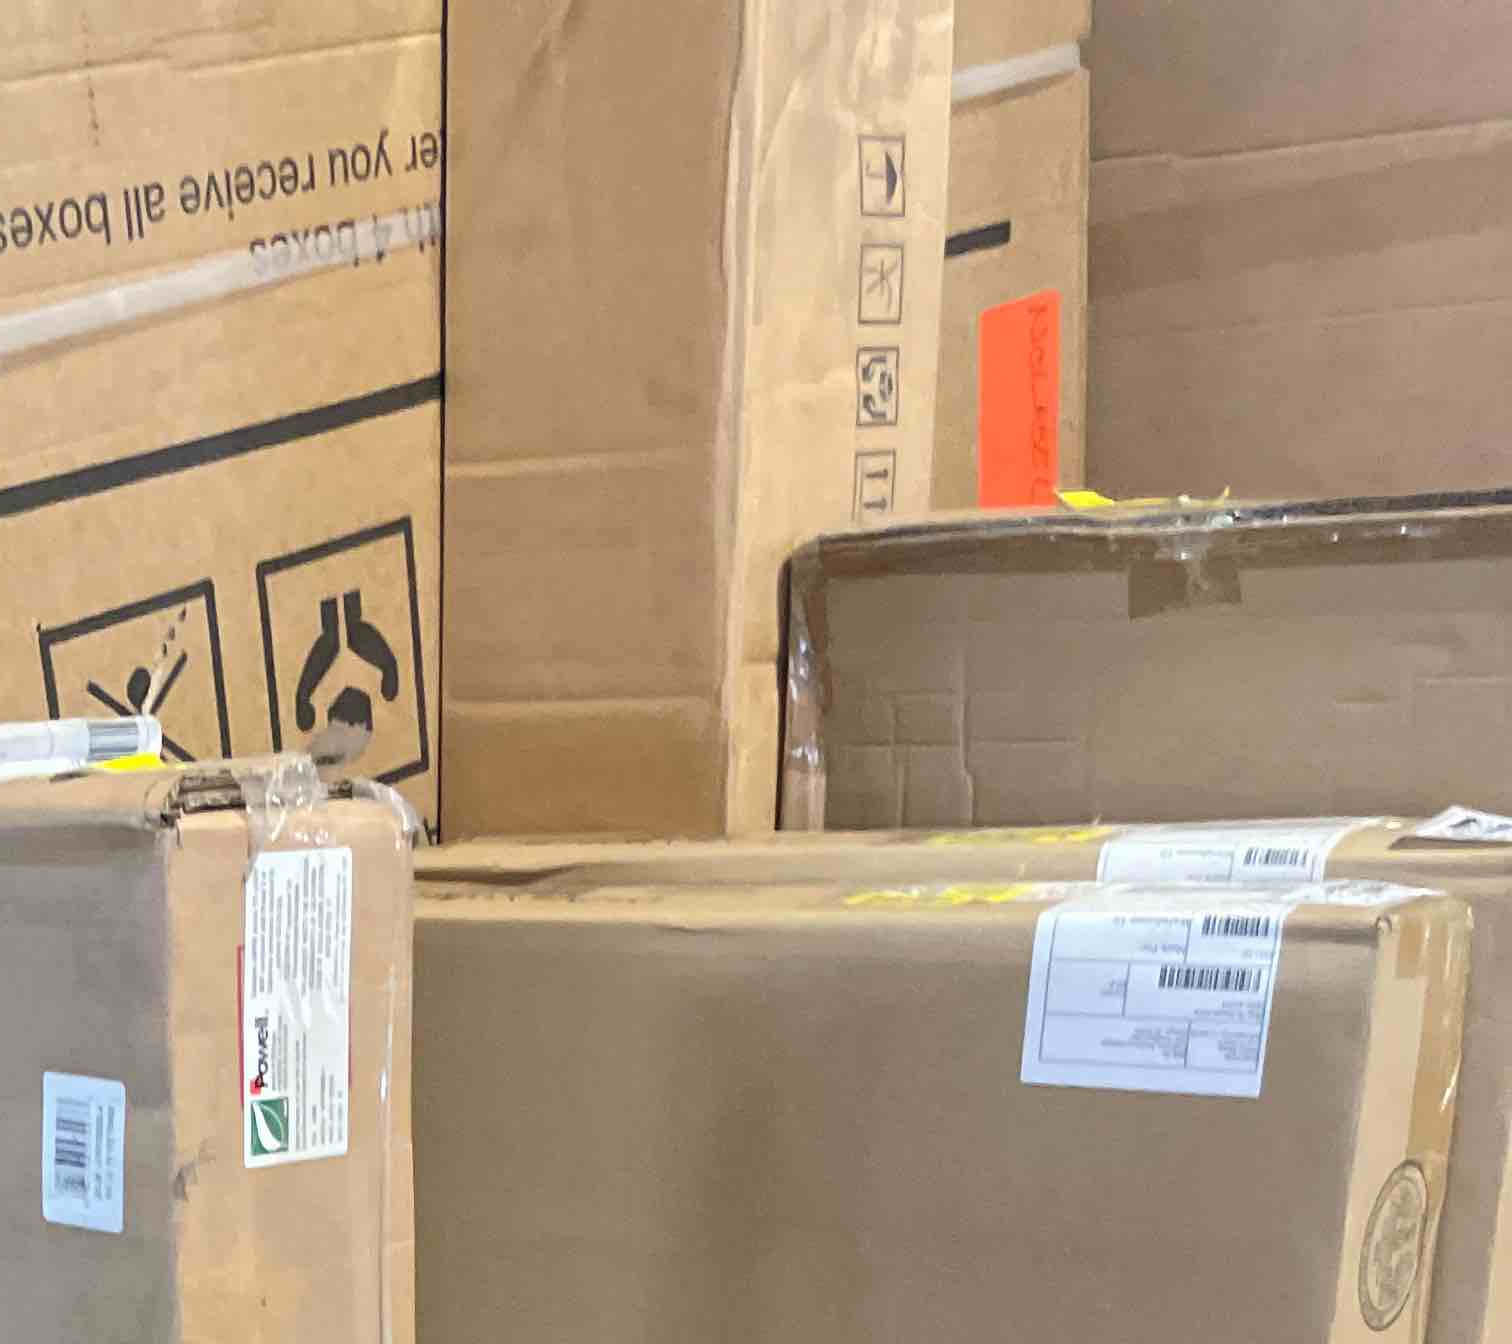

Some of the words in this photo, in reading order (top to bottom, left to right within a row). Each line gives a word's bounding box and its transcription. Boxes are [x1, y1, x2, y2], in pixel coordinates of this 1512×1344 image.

[328, 128, 392, 186] you
[404, 130, 438, 173] er
[122, 182, 165, 241] all
[178, 153, 315, 219] receive
